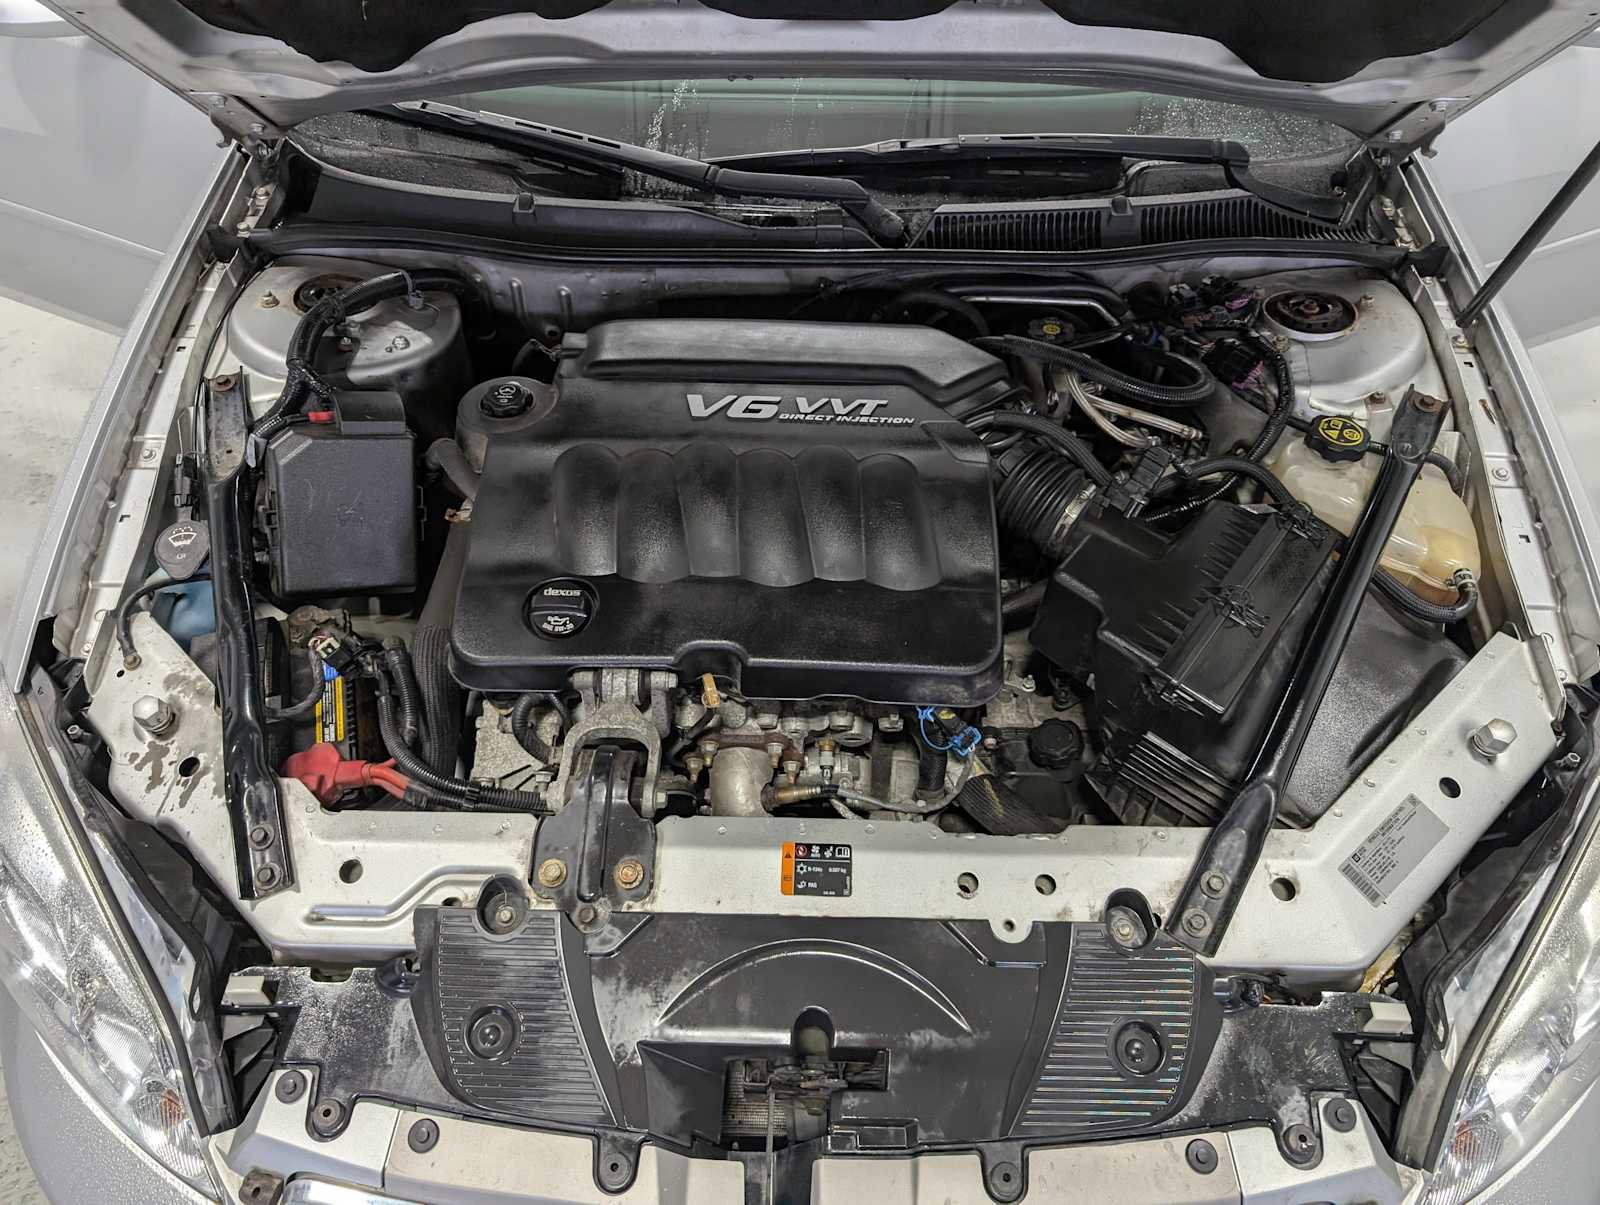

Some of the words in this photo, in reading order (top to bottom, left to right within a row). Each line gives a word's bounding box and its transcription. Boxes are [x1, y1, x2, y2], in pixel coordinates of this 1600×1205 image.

[687, 394, 782, 418] V6
[796, 397, 889, 416] VVT
[778, 413, 834, 422] DIRECT
[836, 415, 915, 424] INJECTION
[543, 587, 582, 596] dexos
